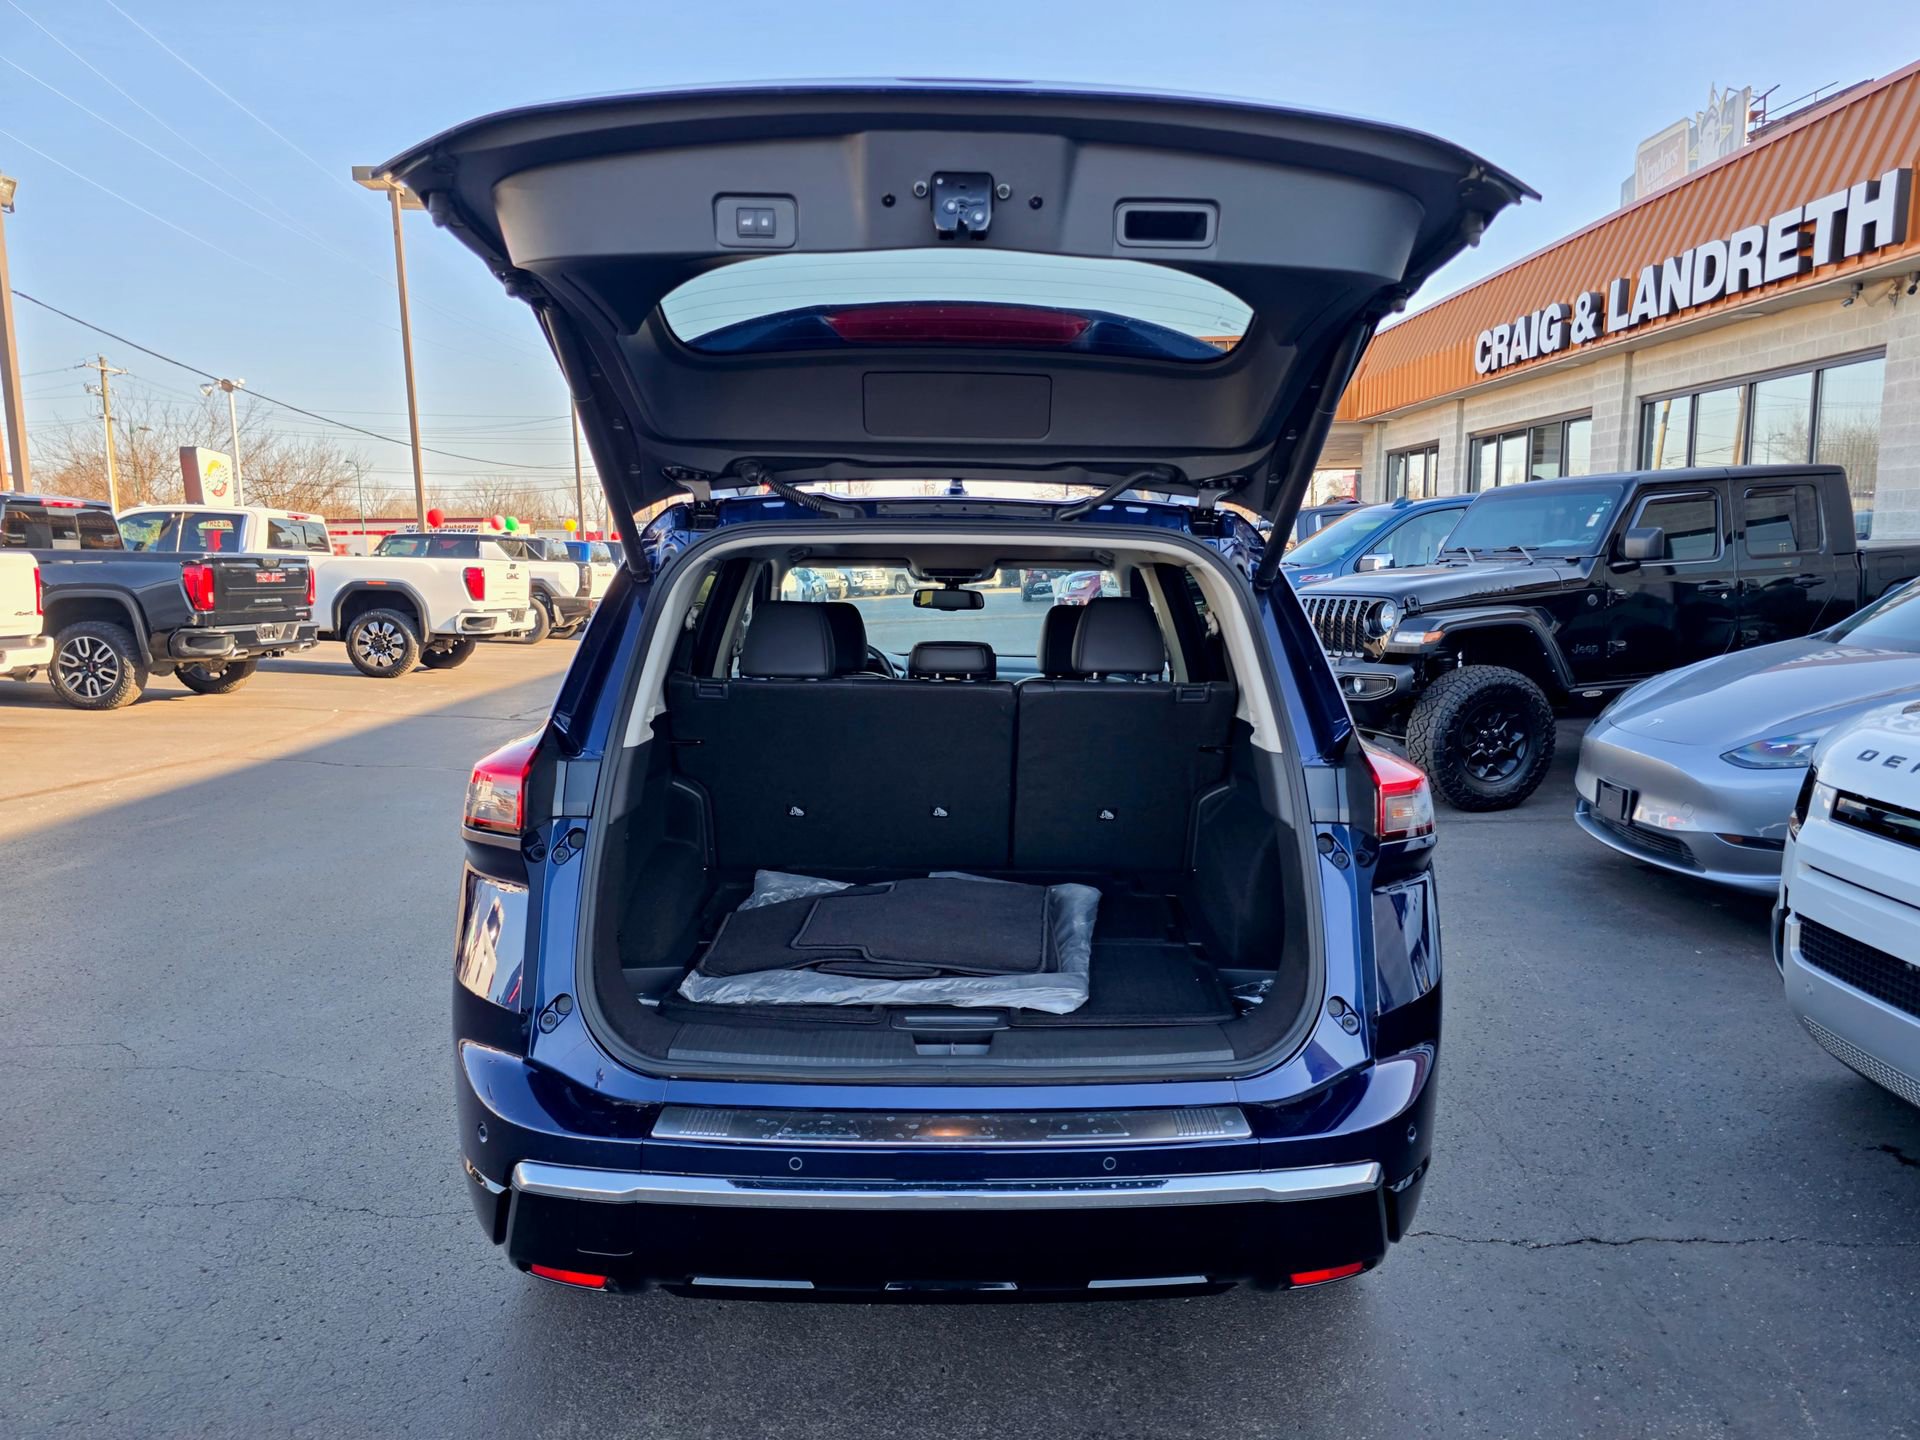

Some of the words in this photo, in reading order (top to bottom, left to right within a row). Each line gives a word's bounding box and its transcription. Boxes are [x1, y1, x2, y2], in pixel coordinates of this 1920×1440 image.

[1474, 303, 1567, 375] CRAIG
[1569, 292, 1600, 344] &
[1607, 168, 1904, 333] LANDRETH
[1571, 643, 1599, 656] Jeep
